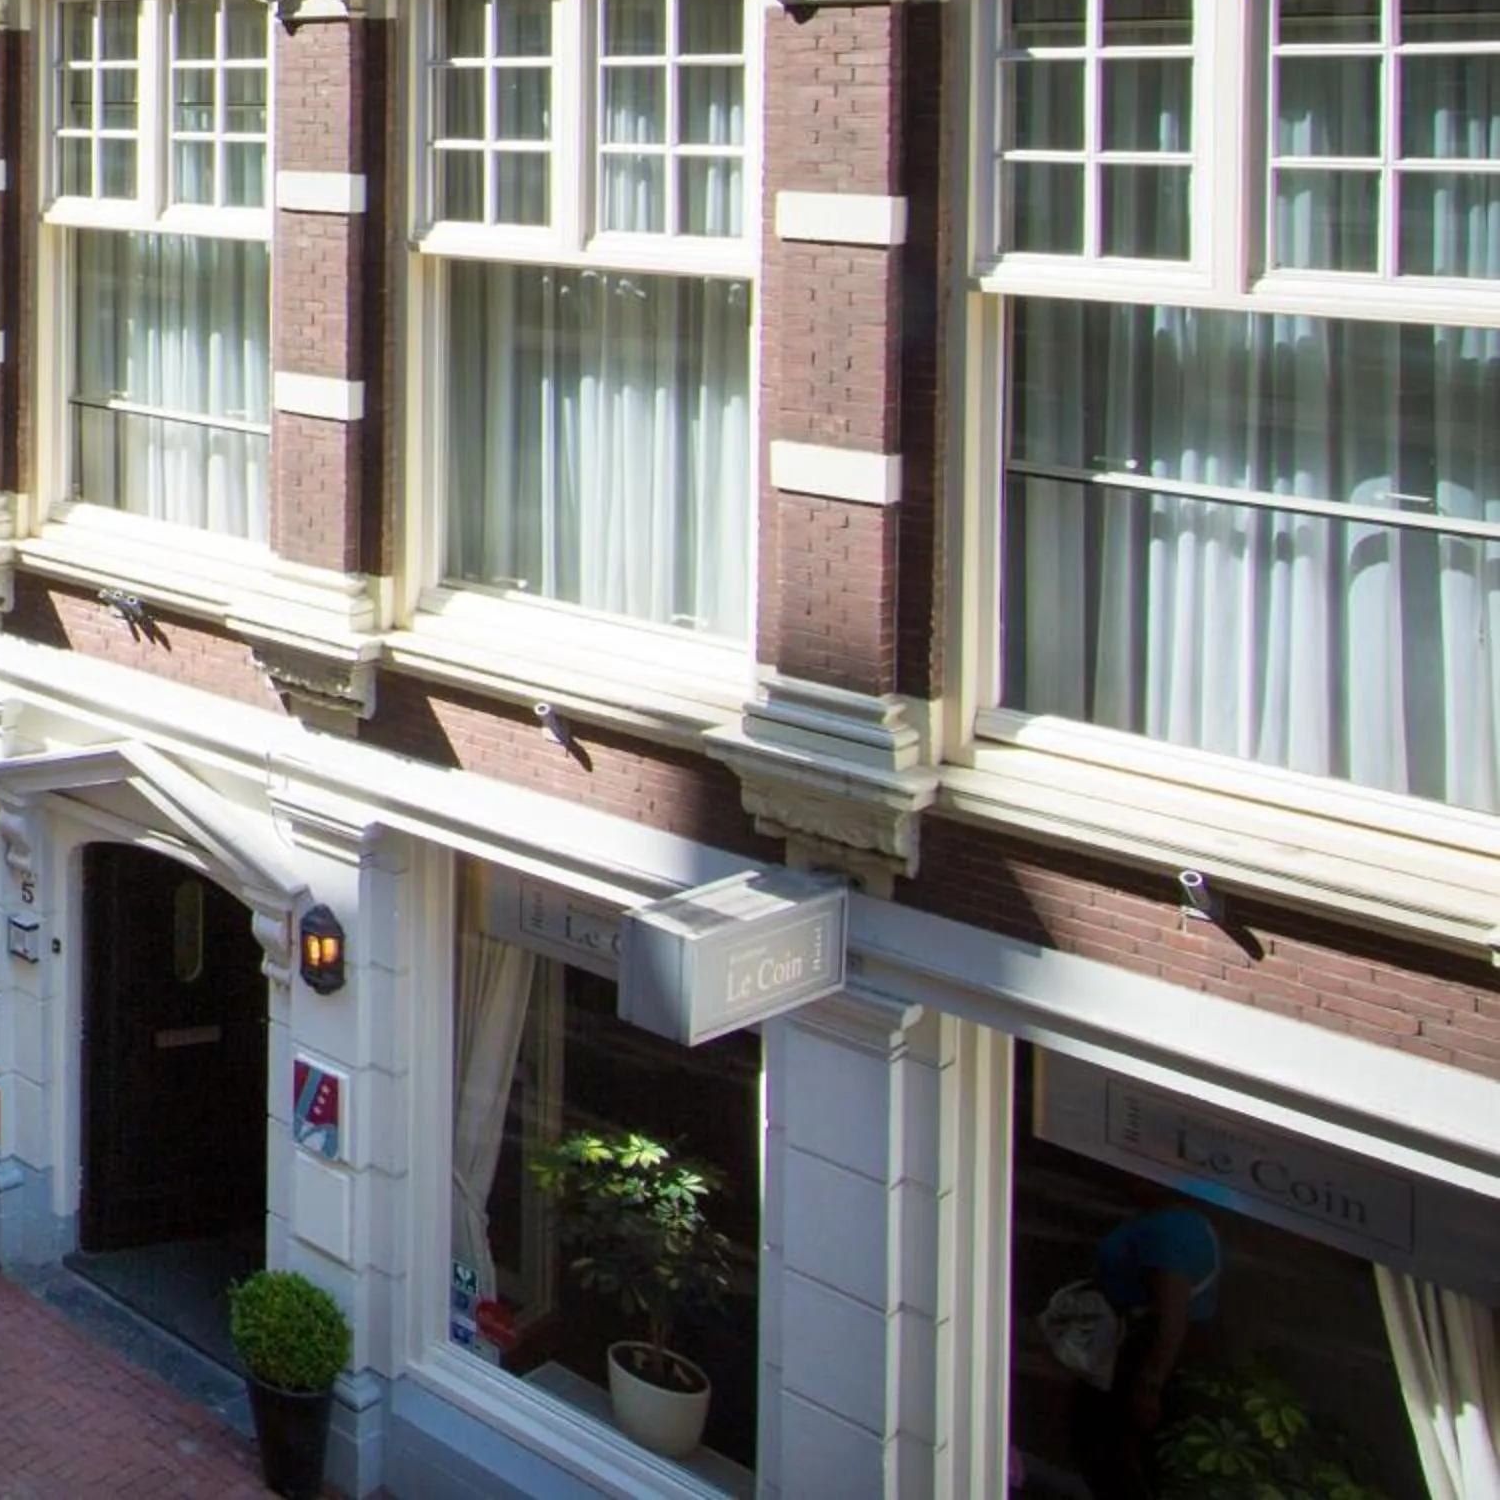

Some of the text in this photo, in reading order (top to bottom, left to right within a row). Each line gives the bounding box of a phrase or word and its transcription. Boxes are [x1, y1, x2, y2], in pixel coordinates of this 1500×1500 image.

[21, 881, 35, 904] 5
[726, 968, 752, 1002] Le
[757, 949, 803, 991] Coin
[1175, 1128, 1235, 1175] Le
[1250, 1159, 1368, 1224] Coin
